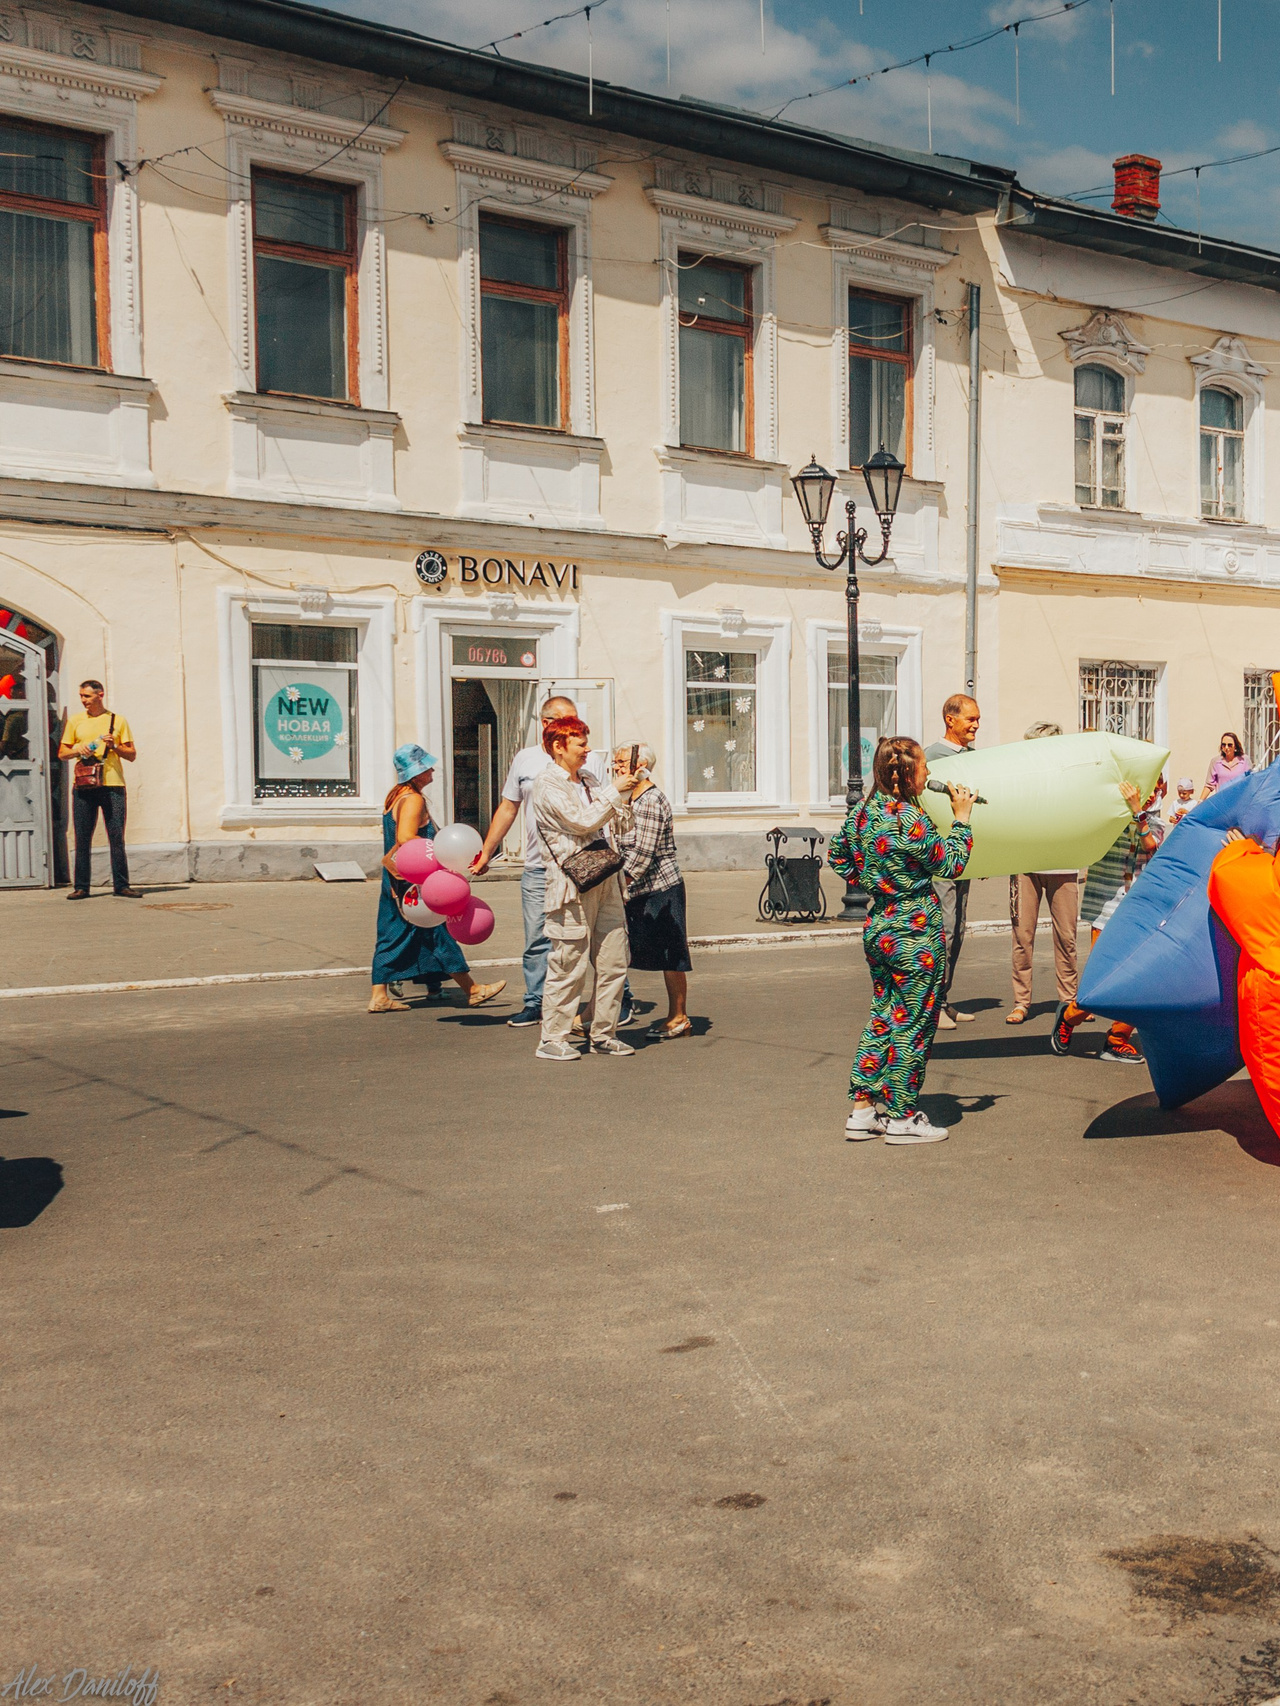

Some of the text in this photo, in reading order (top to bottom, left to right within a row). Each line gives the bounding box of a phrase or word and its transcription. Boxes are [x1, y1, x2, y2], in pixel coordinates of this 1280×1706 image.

[419, 551, 443, 563] ОБУВЬ
[419, 573, 445, 583] СУМКИ
[457, 555, 579, 590] BONAVI
[468, 646, 507, 664] ОБУВЬ
[278, 696, 330, 716] NEW
[277, 719, 331, 733] НОВАЯ
[279, 733, 330, 743] КОЛЛЕКЦИЯ
